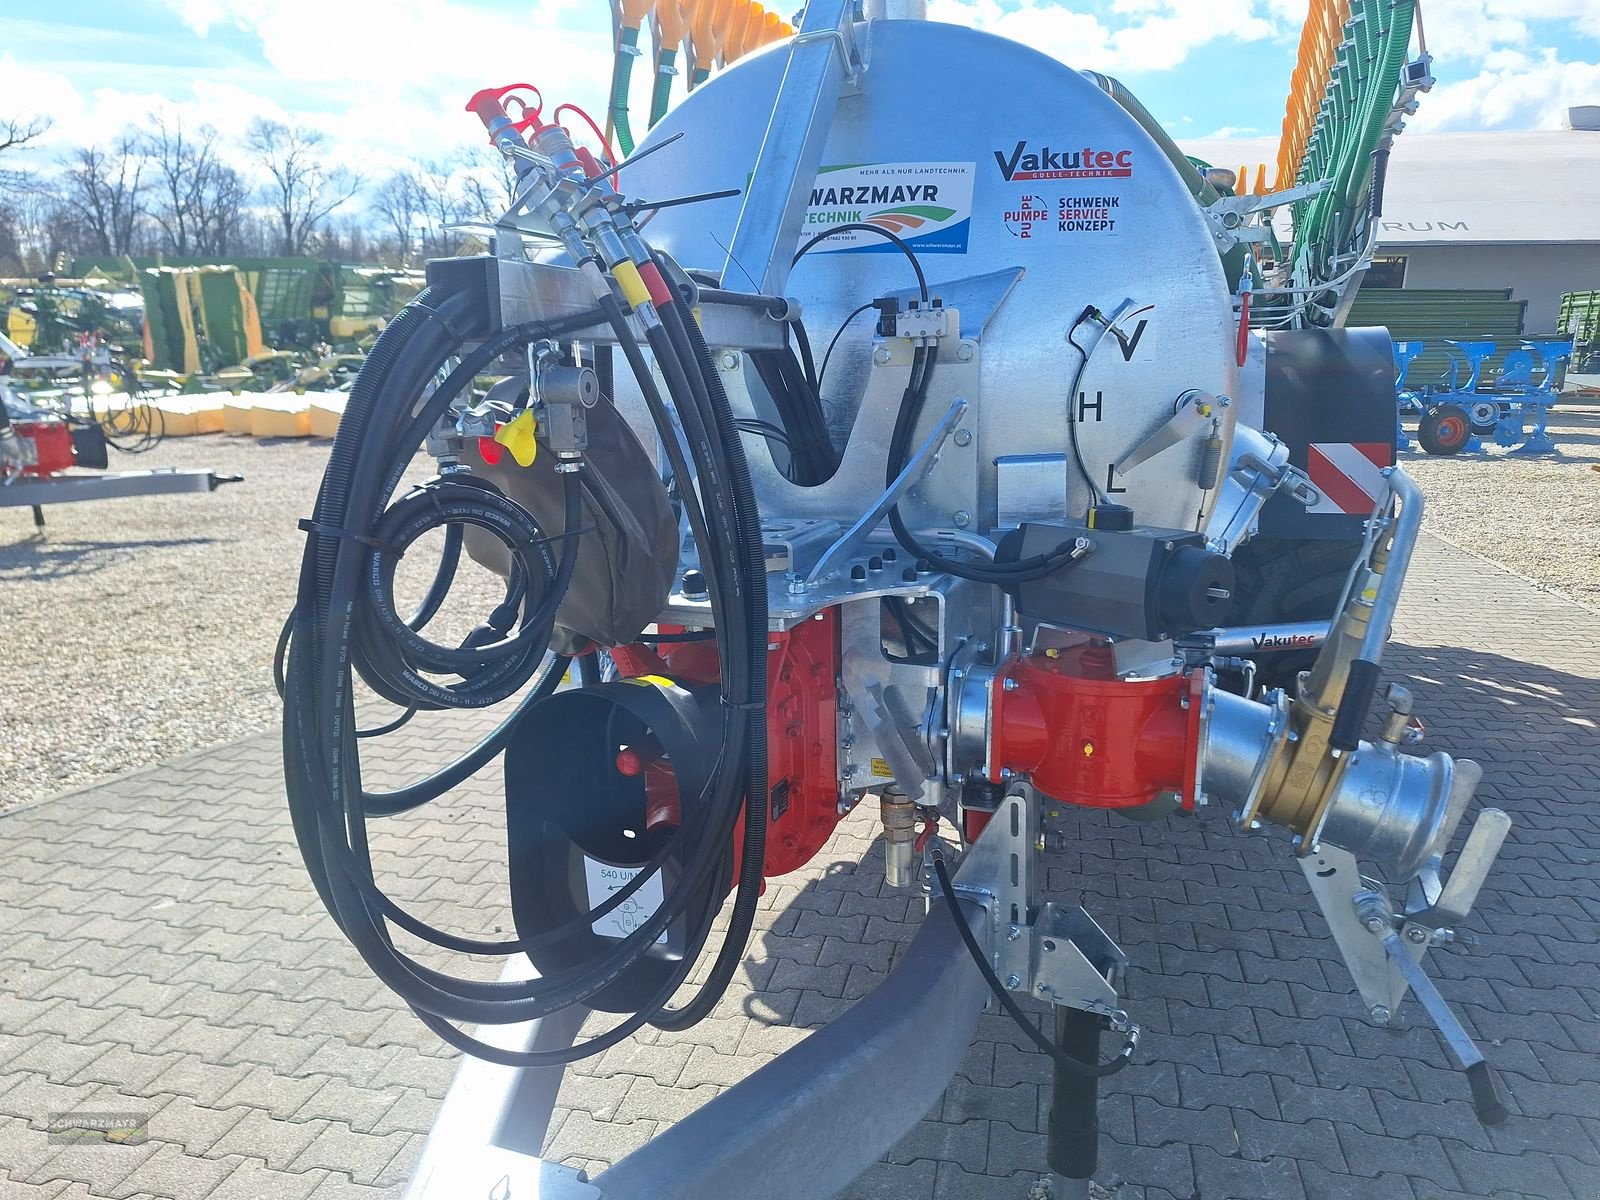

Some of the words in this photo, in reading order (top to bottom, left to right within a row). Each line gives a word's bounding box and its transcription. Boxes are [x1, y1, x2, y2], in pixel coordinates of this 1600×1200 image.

[914, 167, 969, 175] LANDTECHNIK.
[993, 140, 1133, 182] Vakutec
[808, 184, 939, 207] WARZMAYR
[1058, 196, 1120, 209] SCHWENK
[1004, 210, 1048, 222] PUMPE
[1058, 208, 1109, 220] SERVICE
[1058, 220, 1116, 232] KONZEPT
[1116, 319, 1148, 362] V
[1078, 391, 1103, 423] H
[1106, 463, 1126, 494] L
[372, 552, 381, 586] WABCO
[1251, 632, 1316, 650] Vakutec
[401, 669, 429, 692] WABCO
[600, 869, 618, 880] 540
